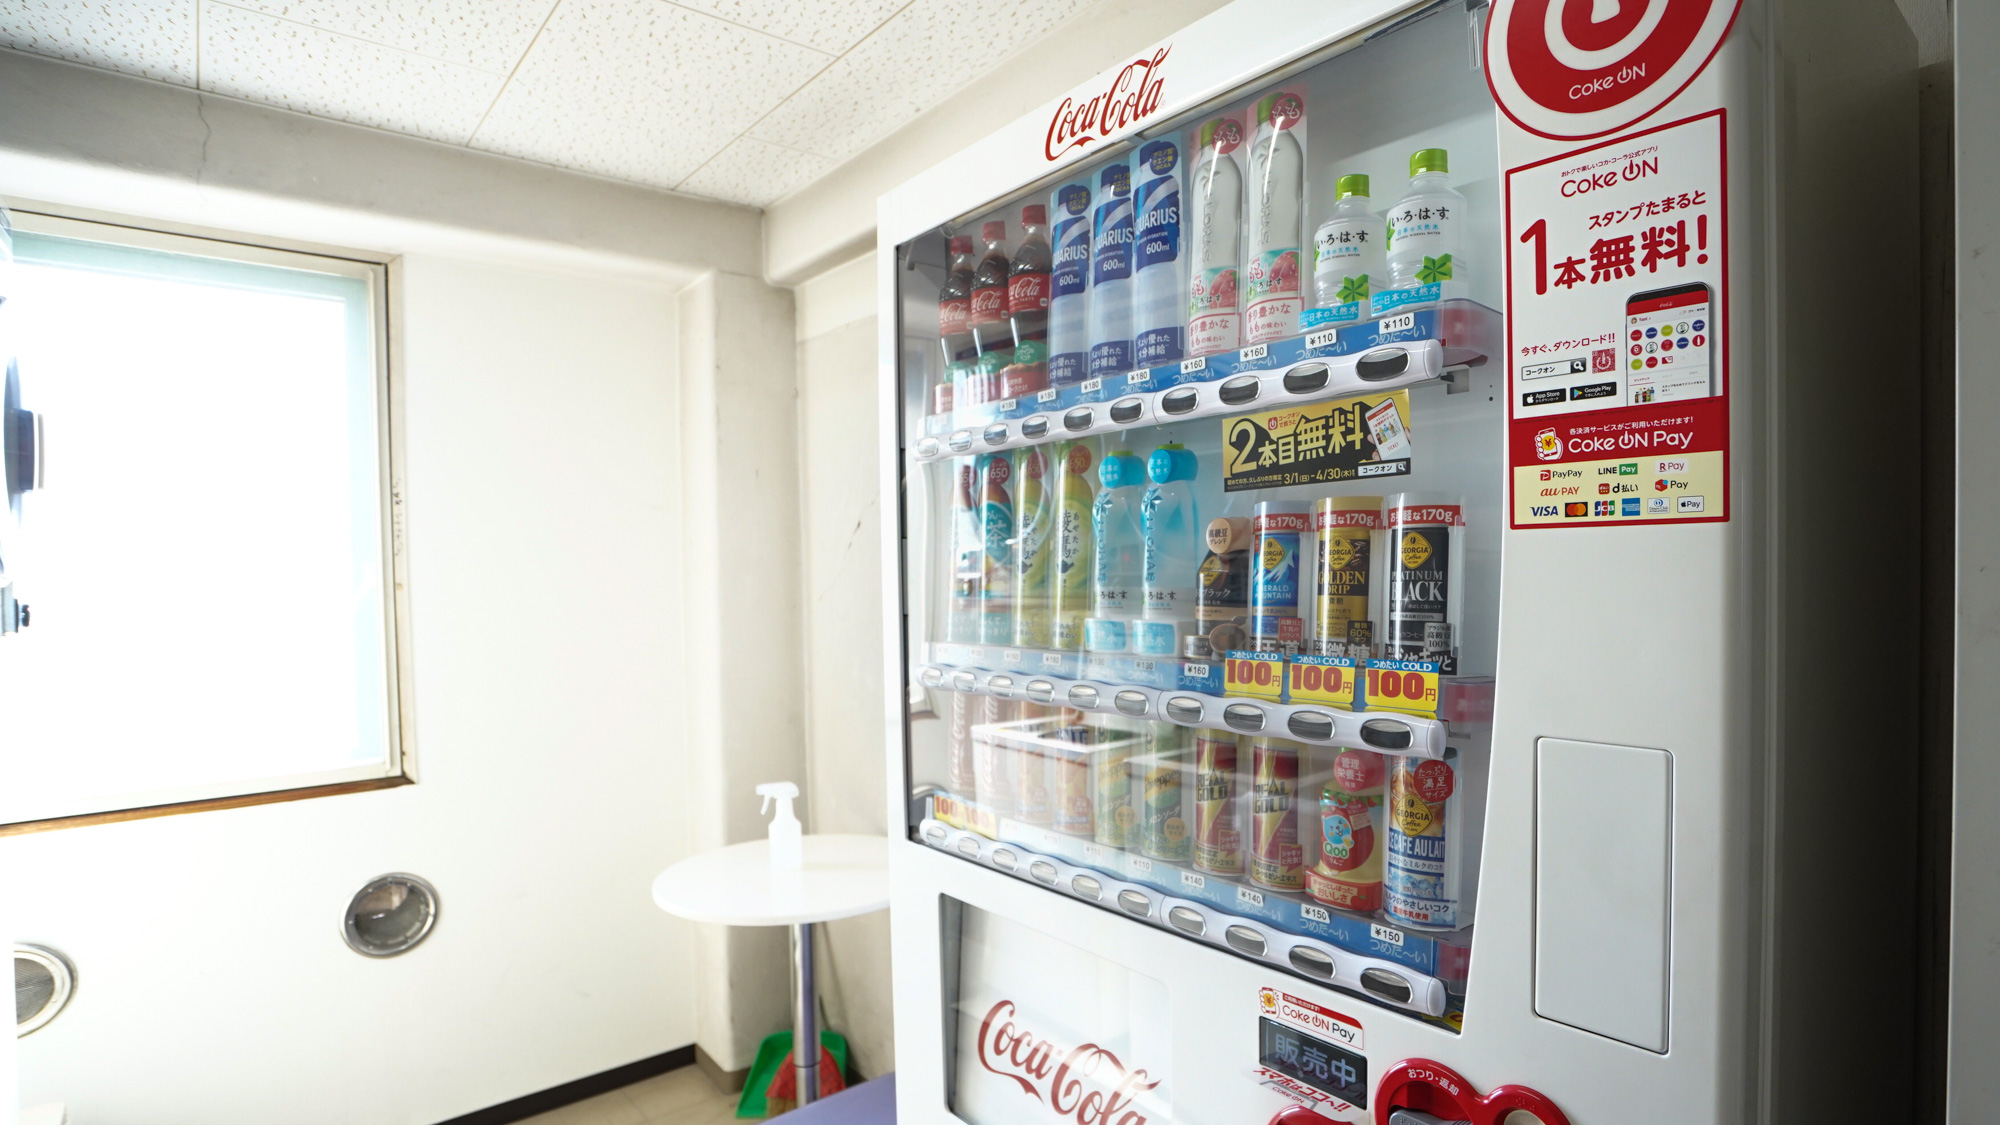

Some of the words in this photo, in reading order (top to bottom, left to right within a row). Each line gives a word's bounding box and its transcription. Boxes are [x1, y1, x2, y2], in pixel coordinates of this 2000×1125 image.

[1568, 75, 1614, 100] Coke
[1617, 62, 1646, 84] ON
[1561, 172, 1618, 198] Coke
[1622, 156, 1658, 181] ON
[1588, 190, 1707, 230] スタンプたまると
[1146, 241, 1170, 255] 600ml
[1103, 259, 1125, 272] 600ml
[1059, 275, 1080, 286] 600ml
[1384, 286, 1440, 305] 日本の天然水
[1309, 305, 1358, 321] 日本の天然水
[1383, 317, 1411, 330] ¥110
[1309, 332, 1333, 346] ¥110
[1521, 333, 1615, 357] 今すぐ、ダウンロード!!
[1243, 347, 1264, 358] ¥160
[1183, 360, 1204, 371] ¥160
[1525, 366, 1556, 376] コークオン
[1131, 371, 1148, 382] ¥180
[1083, 382, 1099, 391] ¥180
[1584, 387, 1601, 395] Google
[1602, 385, 1612, 393] Play
[1230, 404, 1364, 475] 2本目無料
[1568, 435, 1615, 454] Coke
[1618, 431, 1648, 449] ON
[1653, 431, 1693, 450] Pay
[1069, 457, 1086, 469] 650
[1667, 461, 1685, 472] Pay
[990, 467, 1008, 478] 650
[1362, 465, 1393, 474] コークオン
[1552, 469, 1583, 479] PayPay
[1598, 467, 1617, 475] LINE
[1621, 465, 1636, 474] Pay
[1561, 486, 1580, 496] PAY
[1670, 480, 1688, 490] Pay
[1530, 505, 1558, 516] VISA
[1594, 503, 1615, 513] JCB
[1391, 508, 1453, 523] お手軽な170g
[1072, 512, 1080, 555] あやたか
[1208, 528, 1228, 538] 高級豆
[1350, 629, 1371, 638] 60%
[1428, 640, 1450, 648] 100%
[1231, 651, 1252, 659] つめたい
[1253, 652, 1278, 661] COLD
[1297, 656, 1321, 664] つめたい
[1322, 657, 1350, 667] COLD
[1136, 661, 1154, 671] ¥130
[1187, 665, 1206, 675] ¥160
[1373, 660, 1399, 669] つめたい
[1401, 661, 1432, 671] COLD
[1227, 659, 1281, 687] 100円
[1291, 664, 1352, 694] 100円
[1367, 669, 1436, 701] 100円
[1341, 757, 1360, 770] 管理
[1337, 768, 1364, 782] 栄養士
[1418, 765, 1447, 776] たっぷり
[1422, 777, 1446, 789] 満足
[1425, 790, 1448, 799] サイズ
[1396, 809, 1430, 821] GEORGIA
[1323, 841, 1349, 859] Qoo
[1414, 838, 1427, 857] AU
[1429, 840, 1445, 859] LAIT
[1132, 859, 1150, 869] ¥110
[1329, 857, 1344, 866] りんご
[1184, 875, 1203, 886] ¥140
[1240, 891, 1261, 904] ¥140
[1317, 889, 1348, 903] おいしさ
[1305, 908, 1327, 921] ¥150
[1374, 928, 1401, 942] ¥150
[1282, 1004, 1311, 1024] Coke
[1312, 1014, 1330, 1031] ON
[1332, 1022, 1355, 1043] Pay
[1275, 1033, 1357, 1088] 販売中
[1407, 1068, 1460, 1096] おつり・返却
[1272, 1086, 1294, 1099] Coke
